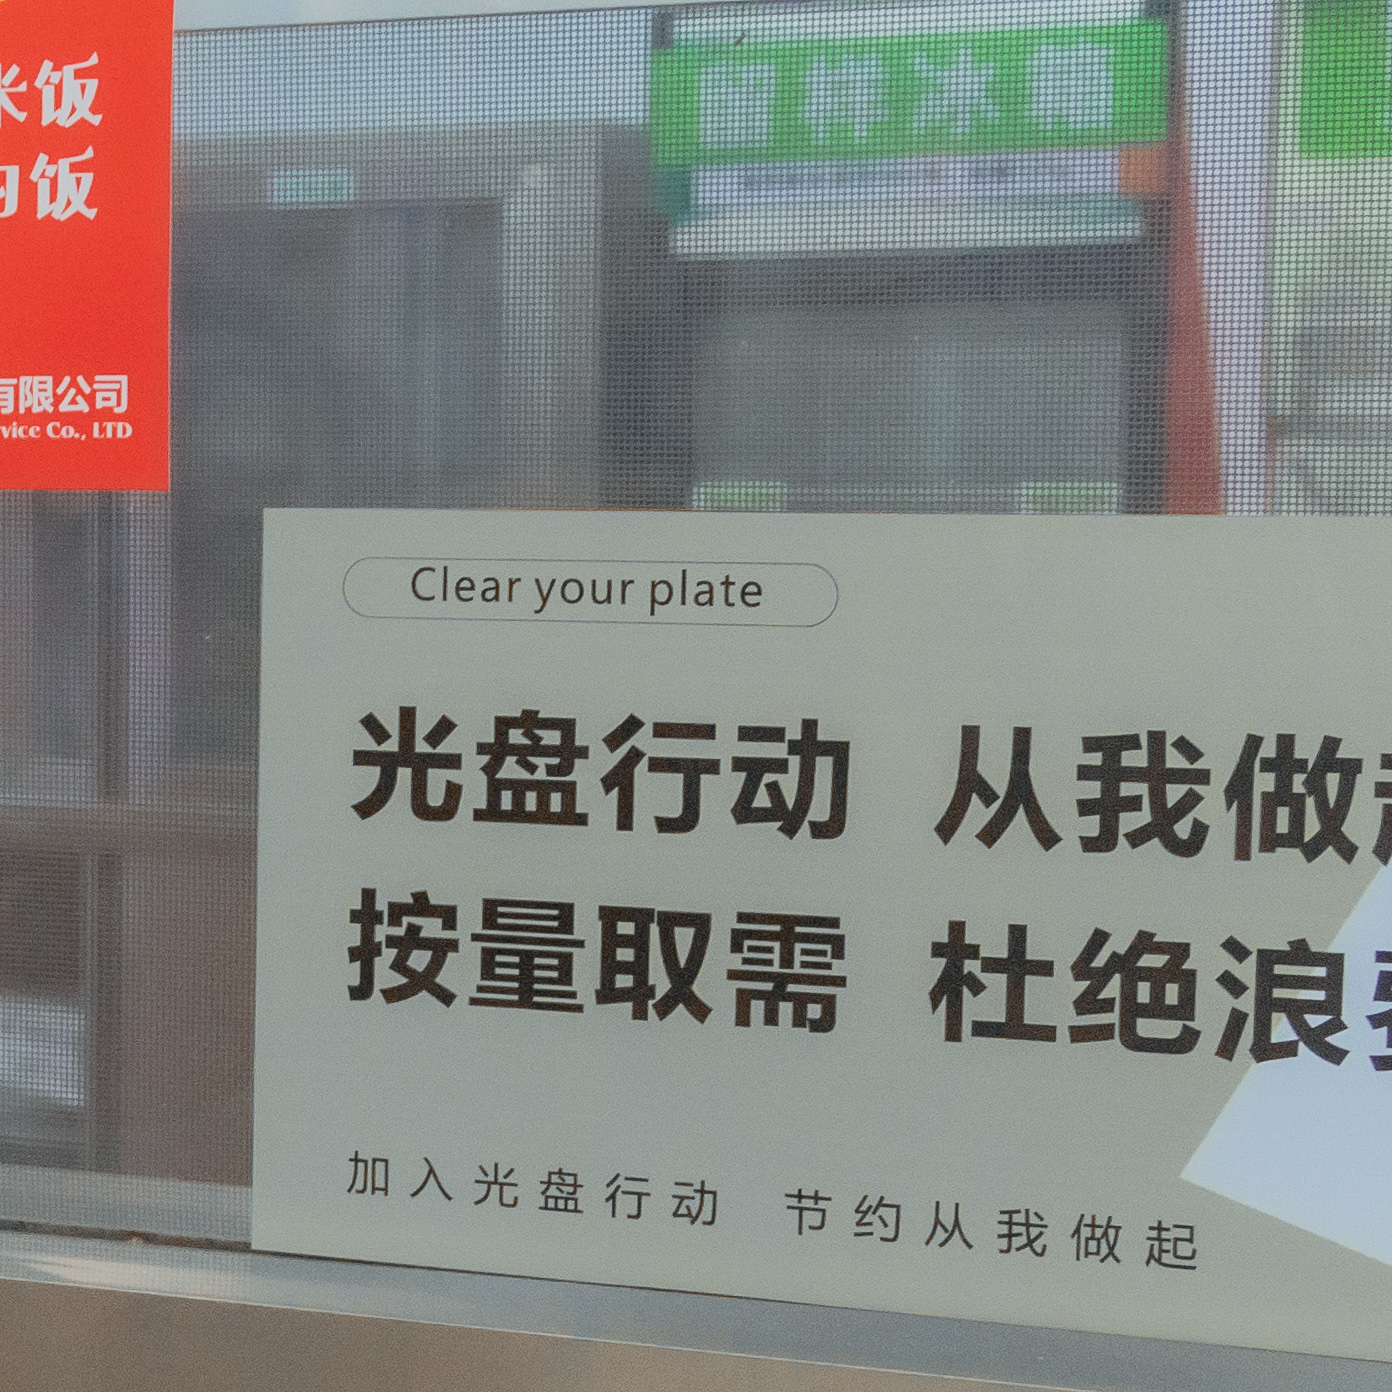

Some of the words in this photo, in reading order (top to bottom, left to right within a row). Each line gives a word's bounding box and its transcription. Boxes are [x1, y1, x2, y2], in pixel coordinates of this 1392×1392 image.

[45, 421, 87, 442] Co.,
[92, 421, 133, 439] LTD
[410, 565, 521, 604] Clear
[534, 577, 635, 615] your
[648, 569, 765, 617] plate
[351, 706, 851, 840] 光盘行动
[347, 888, 848, 1034] 按量取需
[928, 921, 1392, 1072] 杜绝浪
[346, 1150, 721, 1227] 加入光盘行动
[783, 1188, 1201, 1273] 节约从我做起
